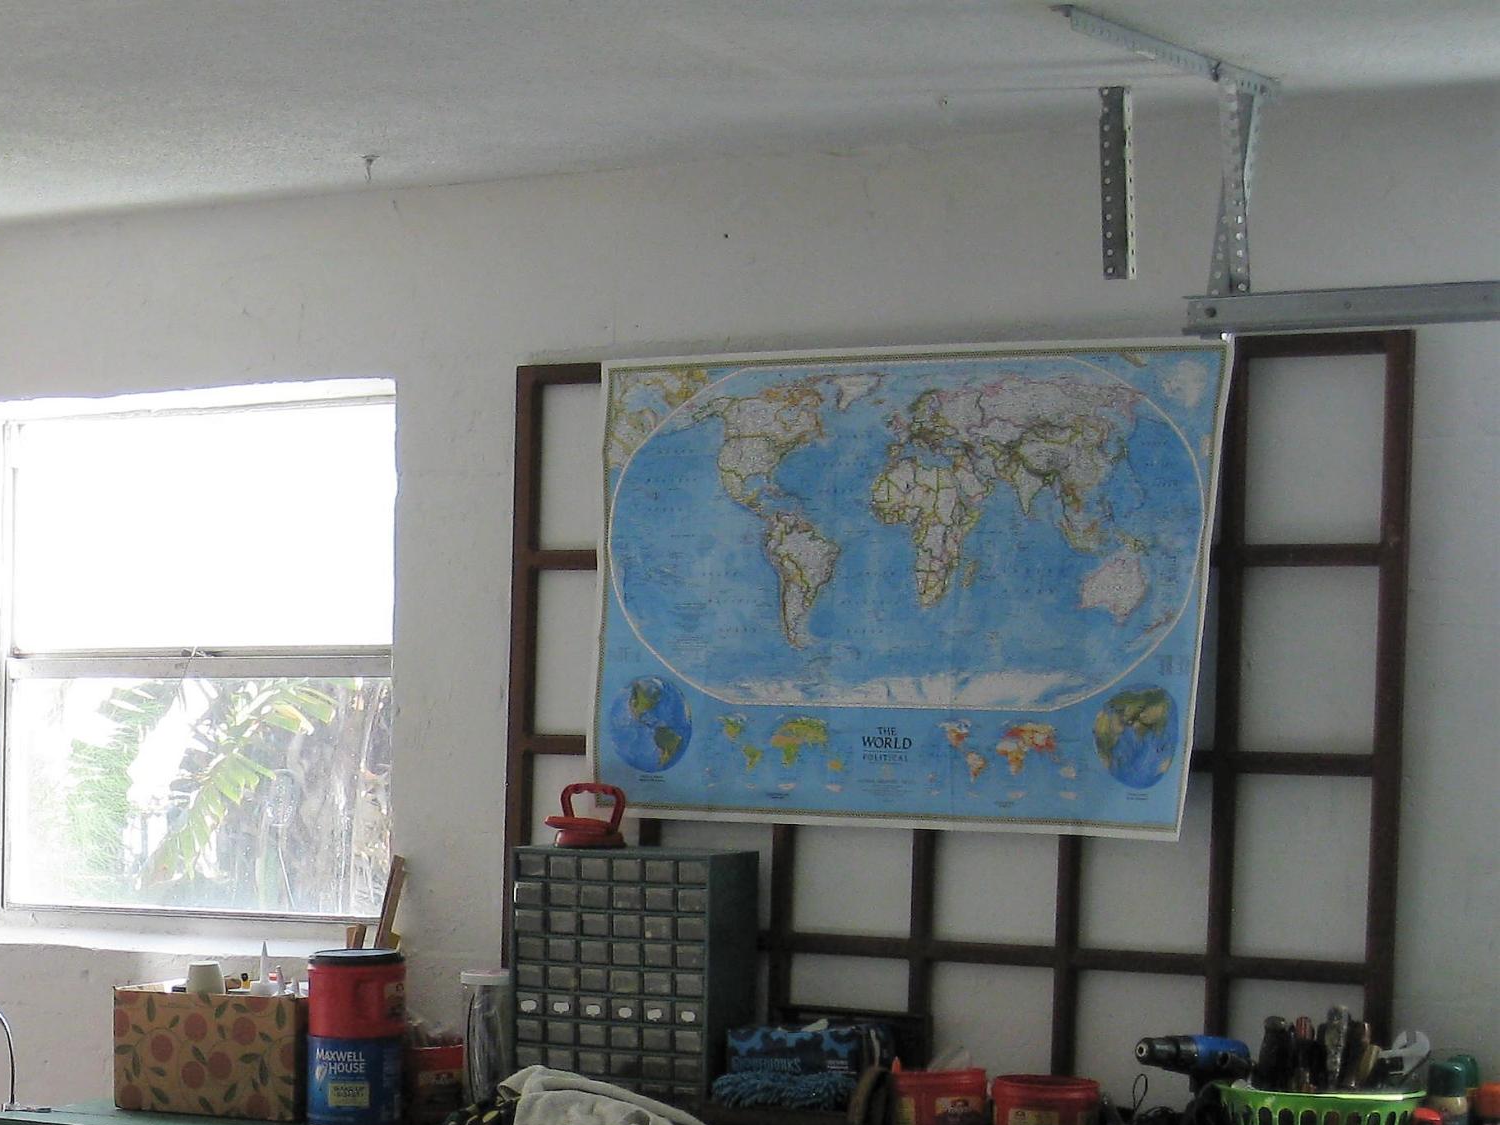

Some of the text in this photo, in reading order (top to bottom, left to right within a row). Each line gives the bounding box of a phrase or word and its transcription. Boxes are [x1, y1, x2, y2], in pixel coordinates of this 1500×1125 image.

[877, 726, 897, 736] THE
[862, 736, 912, 750] WORLD
[315, 1048, 365, 1062] MAXWELL
[328, 1062, 366, 1074] HOUSE
